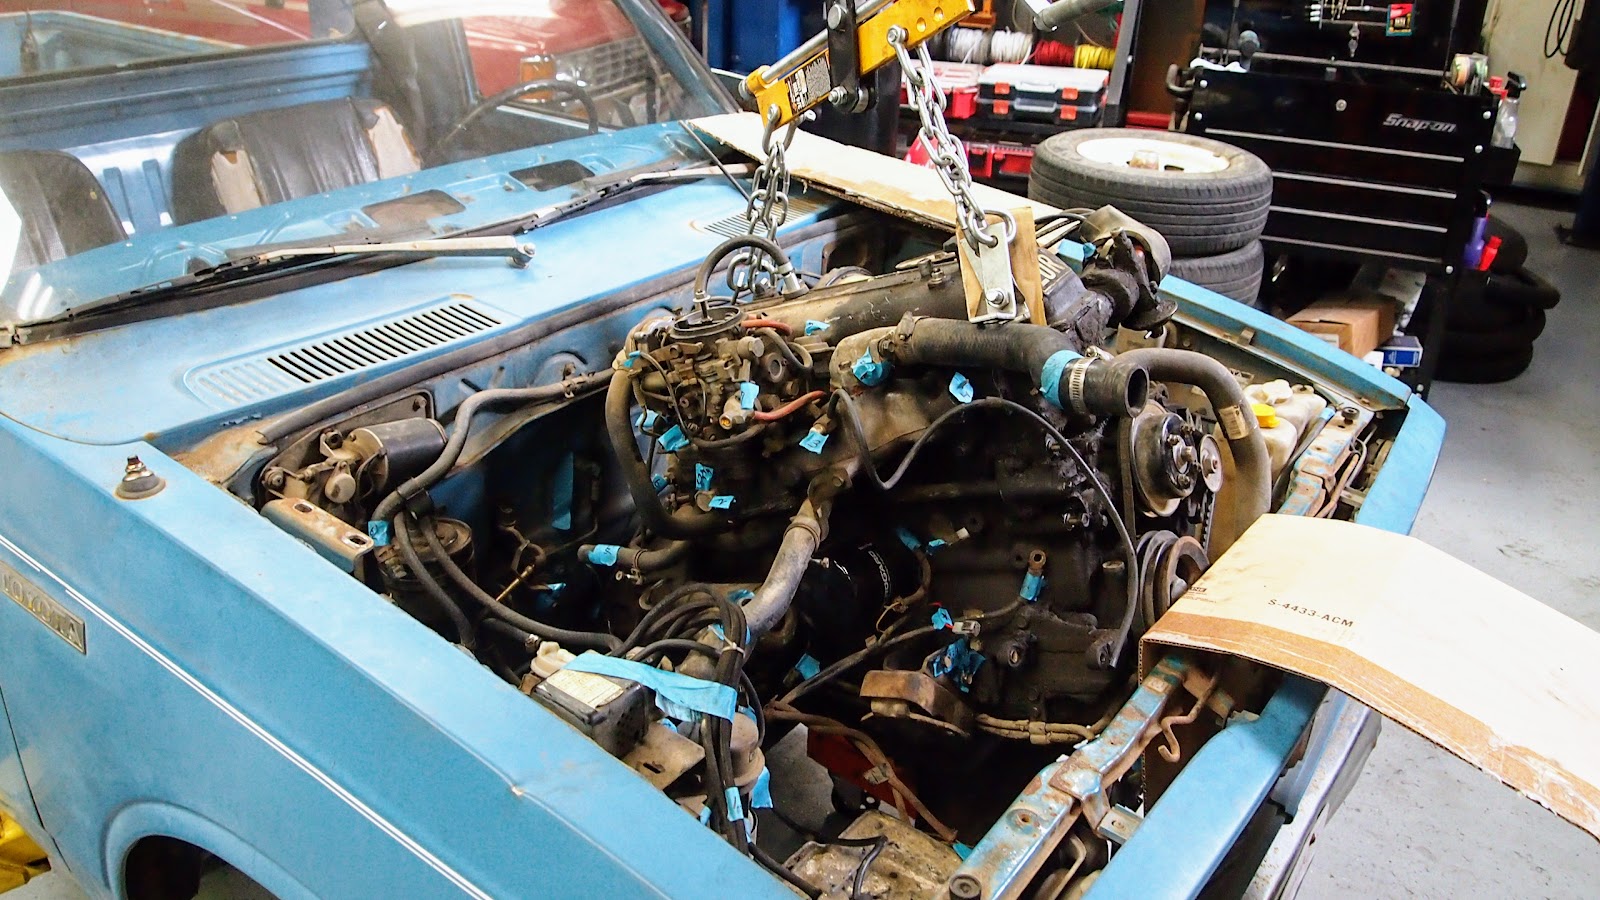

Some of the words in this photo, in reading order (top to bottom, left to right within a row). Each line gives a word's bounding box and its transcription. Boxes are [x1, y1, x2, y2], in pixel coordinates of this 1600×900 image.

[1382, 112, 1457, 133] Snap-on
[1, 572, 83, 648] TOYOTA
[1267, 598, 1354, 628] S-4433-ACM
